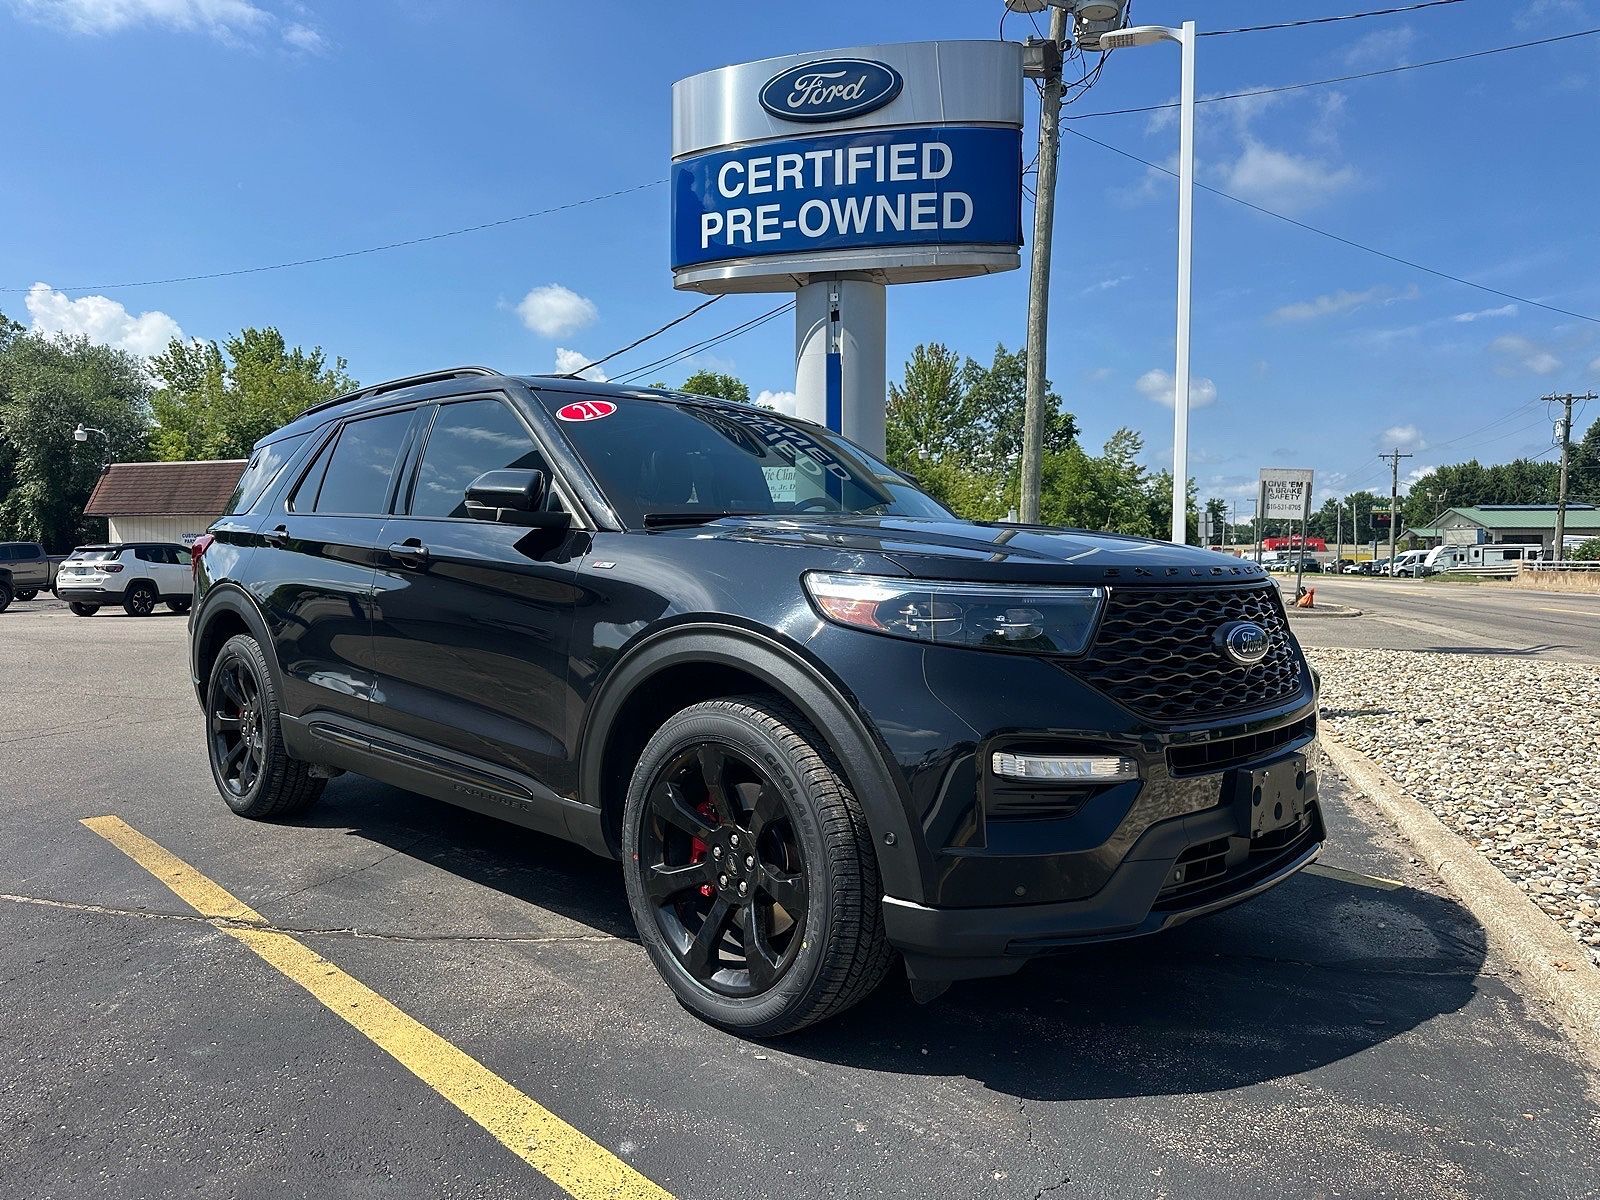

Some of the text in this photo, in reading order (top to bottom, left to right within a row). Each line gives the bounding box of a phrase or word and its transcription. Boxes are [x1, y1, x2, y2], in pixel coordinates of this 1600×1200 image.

[786, 70, 868, 108] Ford
[717, 141, 953, 199] CERTIFIED
[700, 191, 974, 249] PRE-OWNED
[572, 402, 606, 419] 21
[1269, 493, 1300, 501] SAFETY
[1275, 487, 1302, 495] BRAKE
[1103, 565, 1264, 578] EXPLORER
[1241, 631, 1263, 653] Ford
